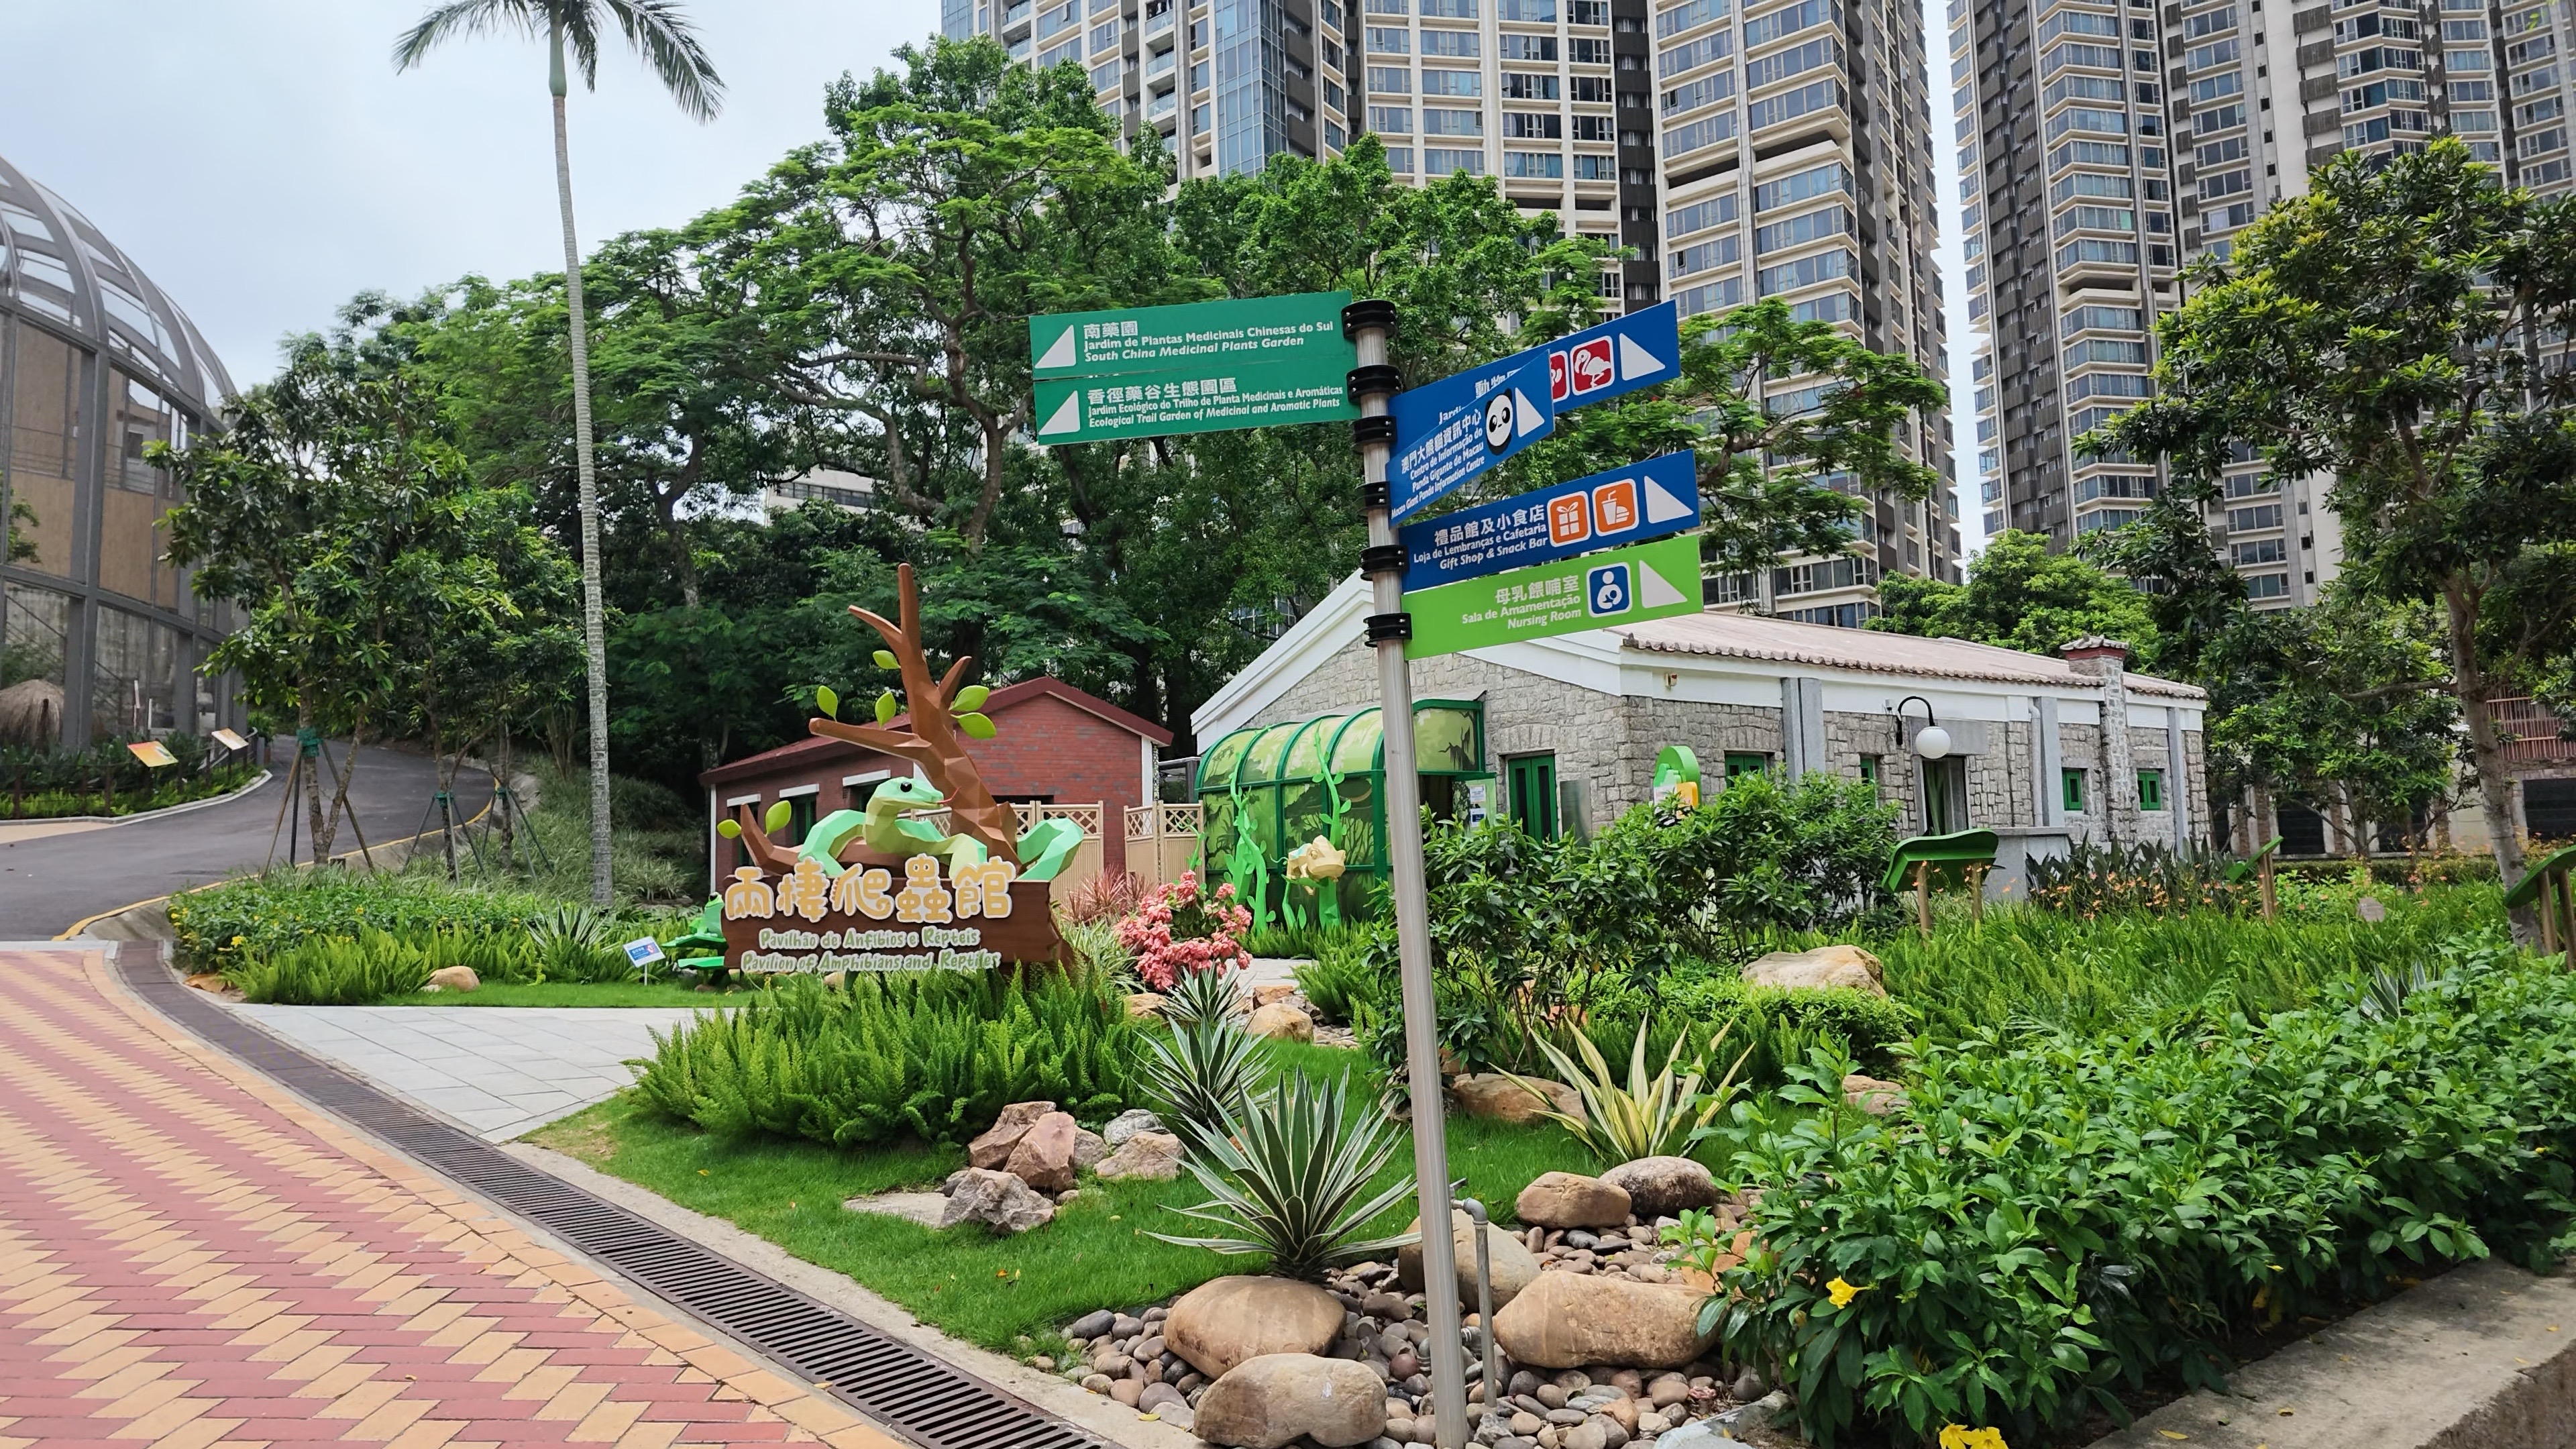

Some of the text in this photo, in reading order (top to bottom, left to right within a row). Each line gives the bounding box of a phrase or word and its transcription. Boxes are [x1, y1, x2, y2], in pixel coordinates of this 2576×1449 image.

[1083, 321, 1138, 339] 南藥園
[1084, 321, 1333, 352] Jardim de Plantas Medicinais Chinesas do Sul
[1085, 336, 1303, 362] South China Medicinal Plants Garden
[1087, 377, 1237, 405] 香徑藥谷生態園區
[1475, 368, 1521, 399] 動物
[1088, 405, 1116, 417] Jardim
[1119, 401, 1158, 413] Ecológico
[1161, 400, 1171, 409] do
[1173, 397, 1199, 409] Trilho
[1201, 396, 1211, 405] de
[1213, 394, 1240, 405] Planta
[1242, 390, 1285, 402] Medicinais
[1295, 385, 1342, 398] Aromáticas
[1089, 398, 1340, 428] Ecological Trail Garden of Medicinal and Aromatic Plants
[1410, 427, 1483, 480] Centro de Informação do
[1413, 442, 1484, 493] Panda Gigante de Macau
[1406, 495, 1418, 509] Giant
[1419, 486, 1434, 502] Panda
[1435, 467, 1465, 492] Information
[1466, 456, 1485, 472] Centre
[1434, 504, 1545, 547] 禮品館及小食店
[1413, 551, 1431, 564] Loja
[1433, 548, 1442, 558] de
[1444, 537, 1493, 555] Lembranças
[1503, 523, 1546, 541] Cafetaria
[1440, 537, 1548, 570] Gift Shop & Snack Bar
[1495, 575, 1579, 604] 母乳餵哺室
[1462, 594, 1580, 624] Sala de Amamentação
[1507, 608, 1581, 629] Nursing Room
[725, 853, 1016, 924] 兩棲爬蟲館
[760, 929, 817, 948] Pavilhão
[822, 932, 839, 948] de
[844, 929, 904, 949] Anfíbios
[908, 933, 917, 946] e
[743, 950, 1000, 971] Pavilion of Amphibians and Reptiles
